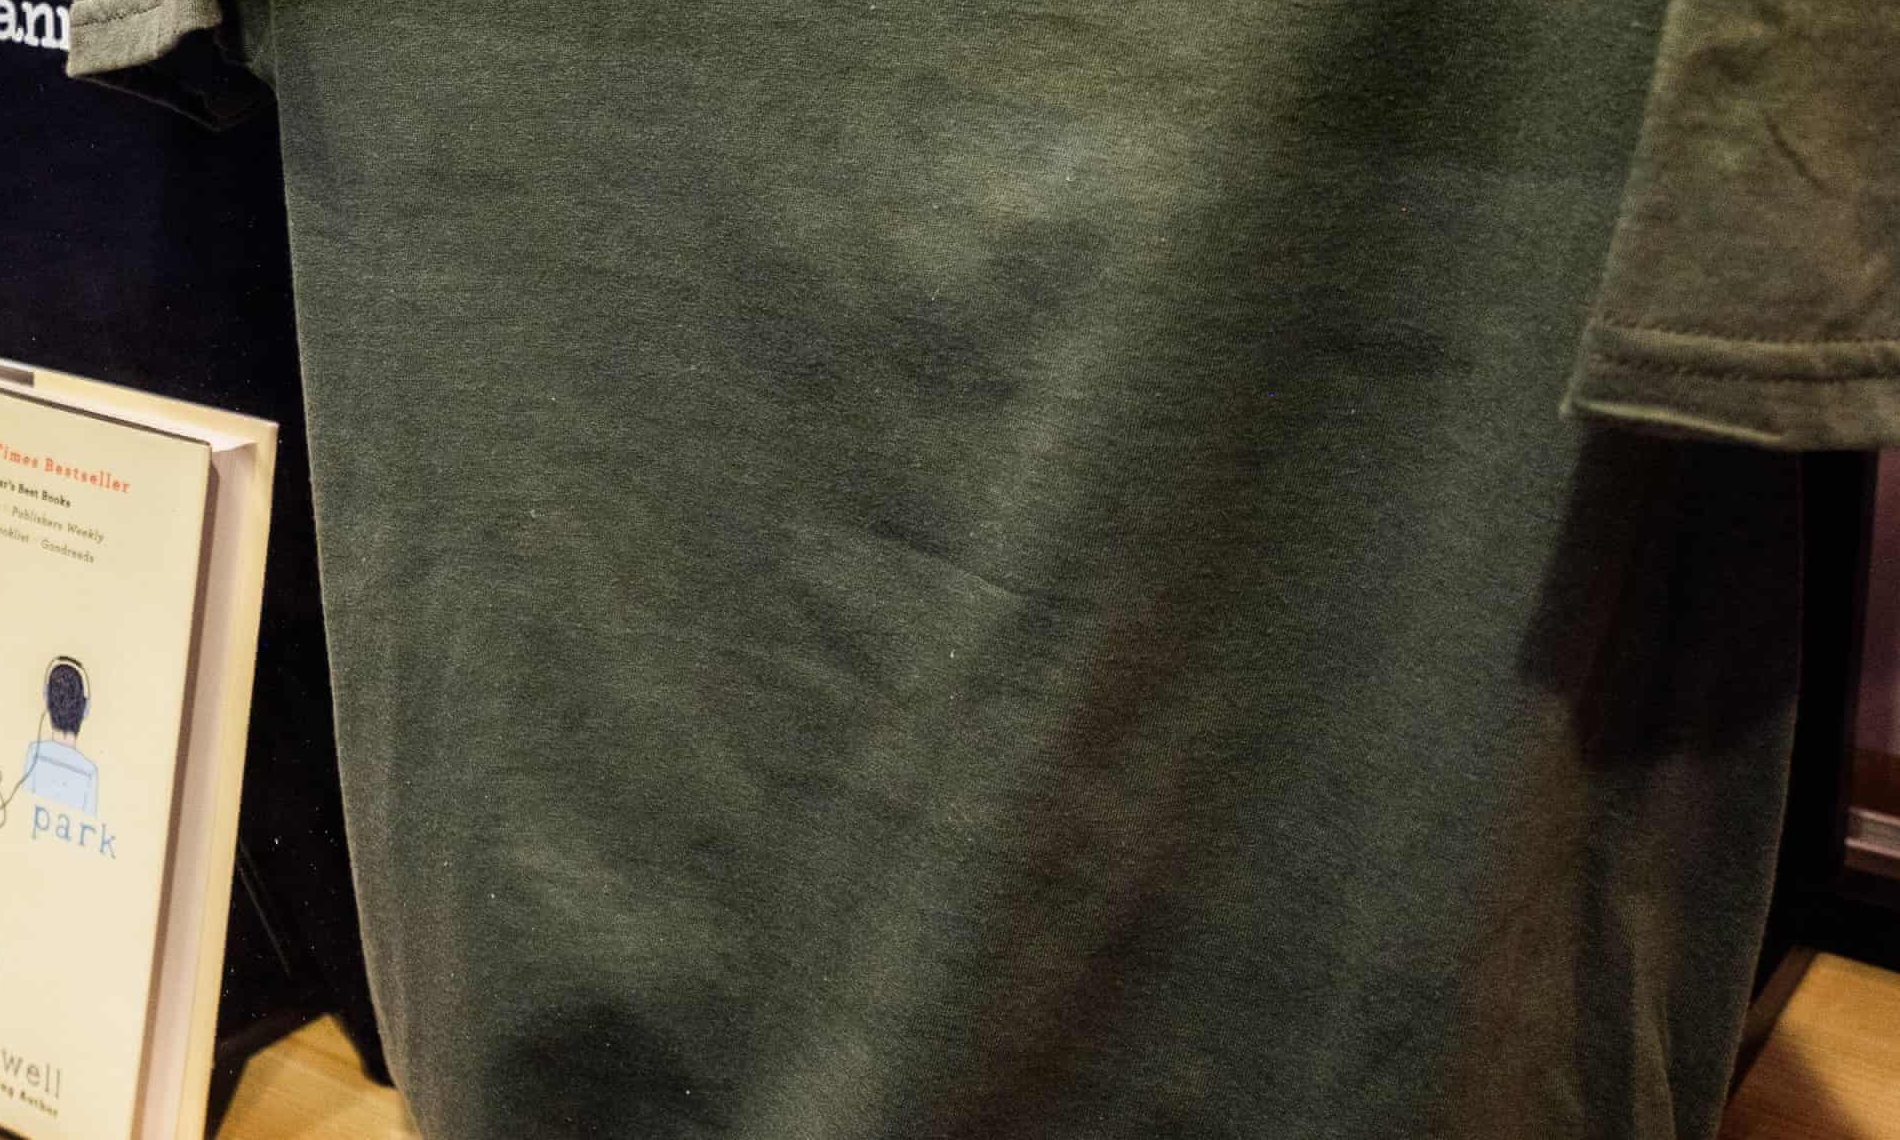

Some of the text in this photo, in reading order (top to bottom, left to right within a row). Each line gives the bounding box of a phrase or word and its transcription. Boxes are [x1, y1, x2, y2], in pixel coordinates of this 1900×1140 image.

[44, 457, 130, 493] Bestseller
[18, 483, 39, 500] Best
[41, 489, 71, 510] Books
[12, 505, 63, 532] Publishers
[32, 805, 116, 859] park
